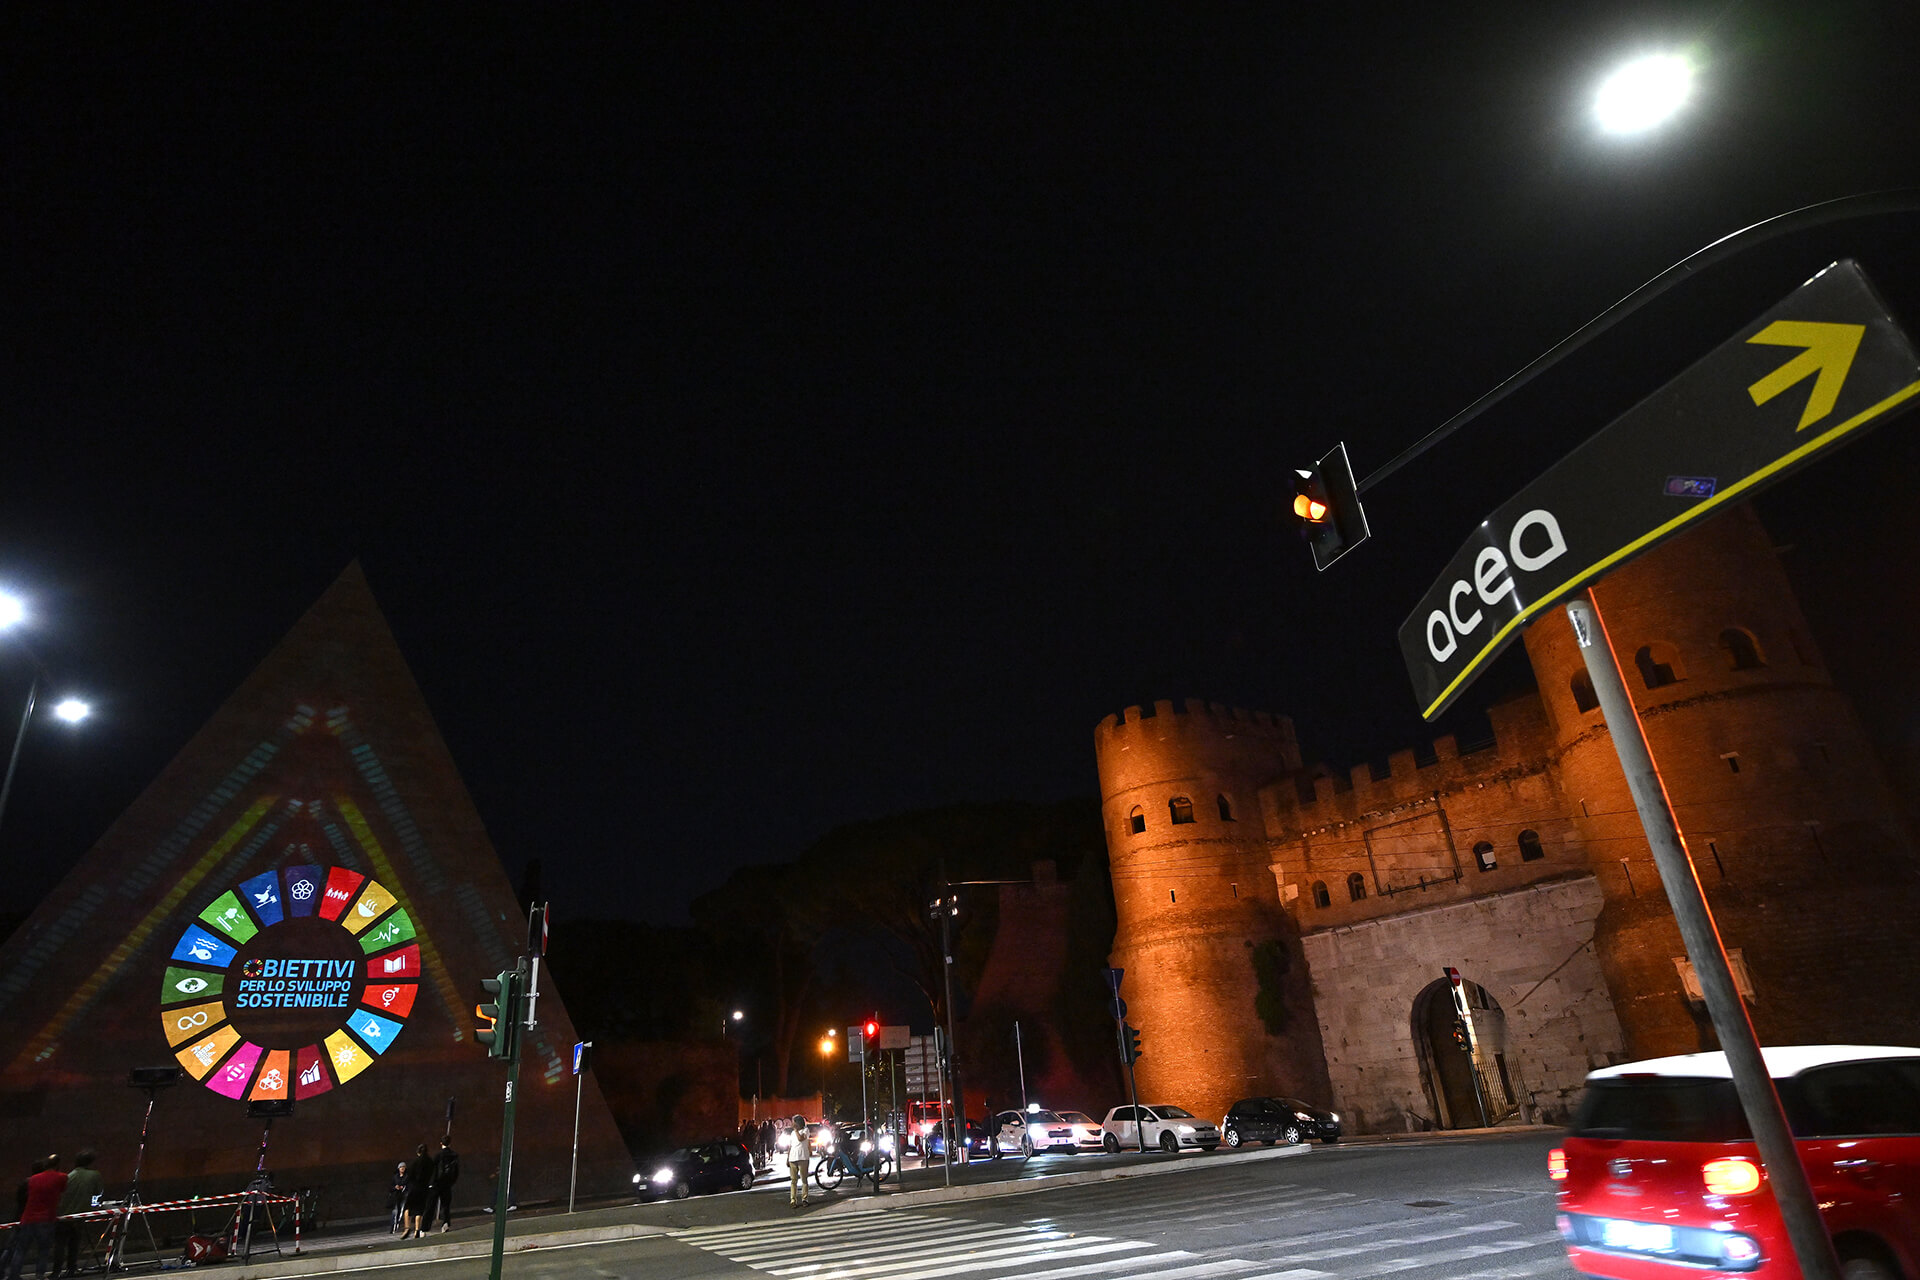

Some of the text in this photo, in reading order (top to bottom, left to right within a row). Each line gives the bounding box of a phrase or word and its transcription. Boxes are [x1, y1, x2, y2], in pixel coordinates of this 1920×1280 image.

[1426, 509, 1568, 663] acea
[243, 959, 356, 978] OBIETTIVI
[239, 980, 352, 992] PER LO SVILUPPO
[236, 993, 350, 1008] SOSTENIBILE
